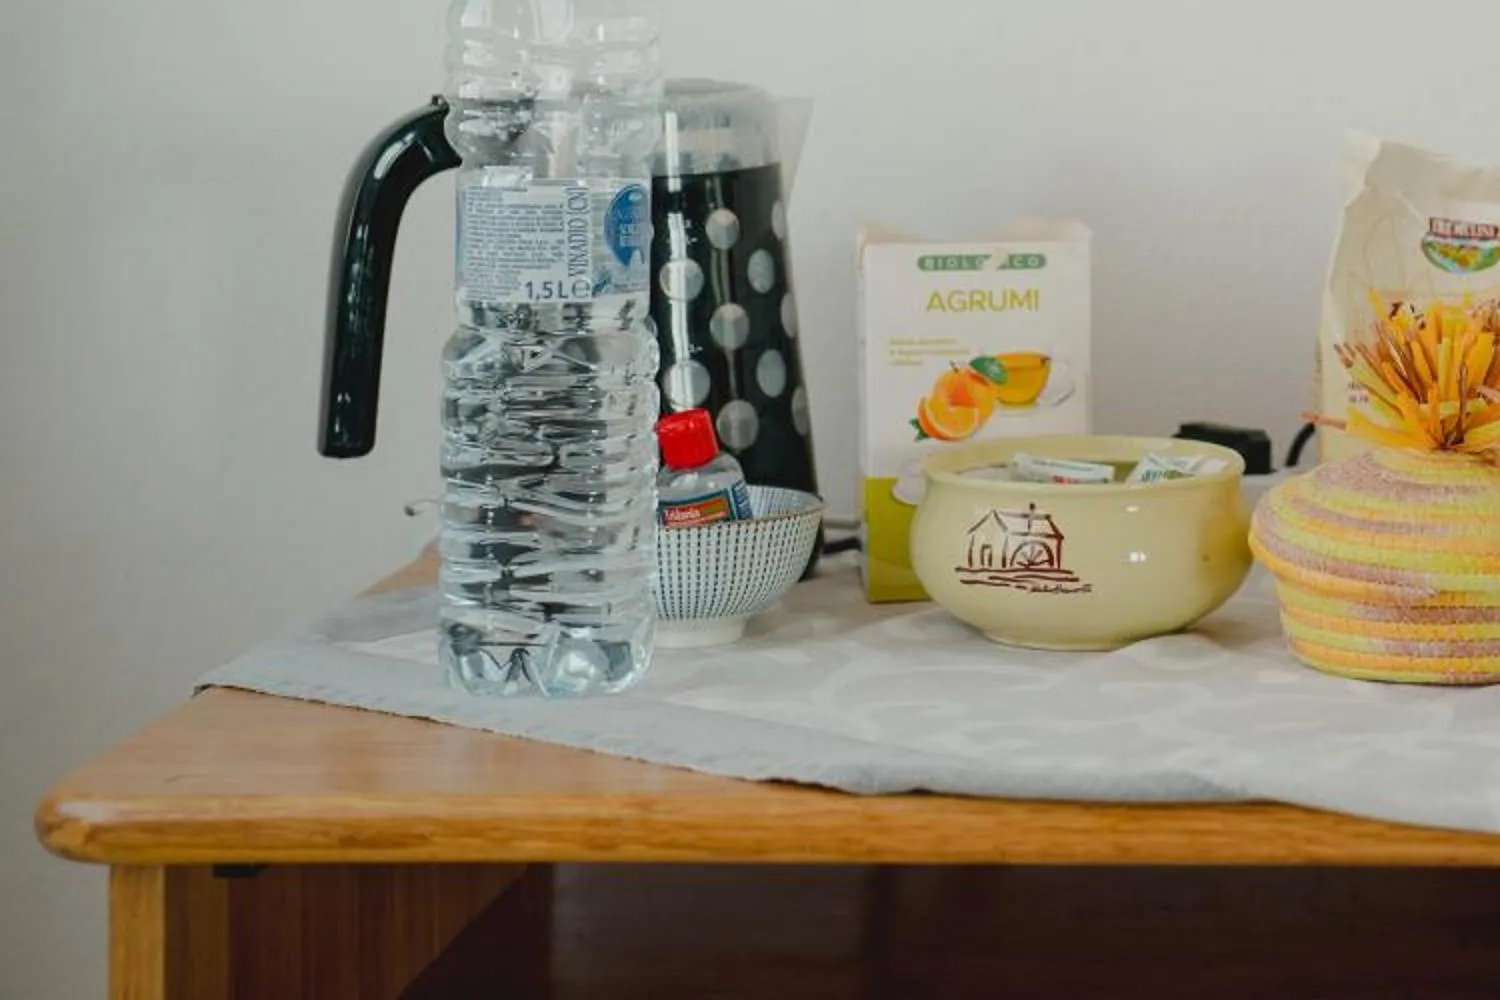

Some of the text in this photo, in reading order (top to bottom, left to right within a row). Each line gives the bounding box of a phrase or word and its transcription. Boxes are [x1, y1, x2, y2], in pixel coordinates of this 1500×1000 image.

[567, 218, 589, 277] VINADIO
[924, 255, 1039, 269] BIOLOCO
[926, 288, 1040, 312] AGRUMI
